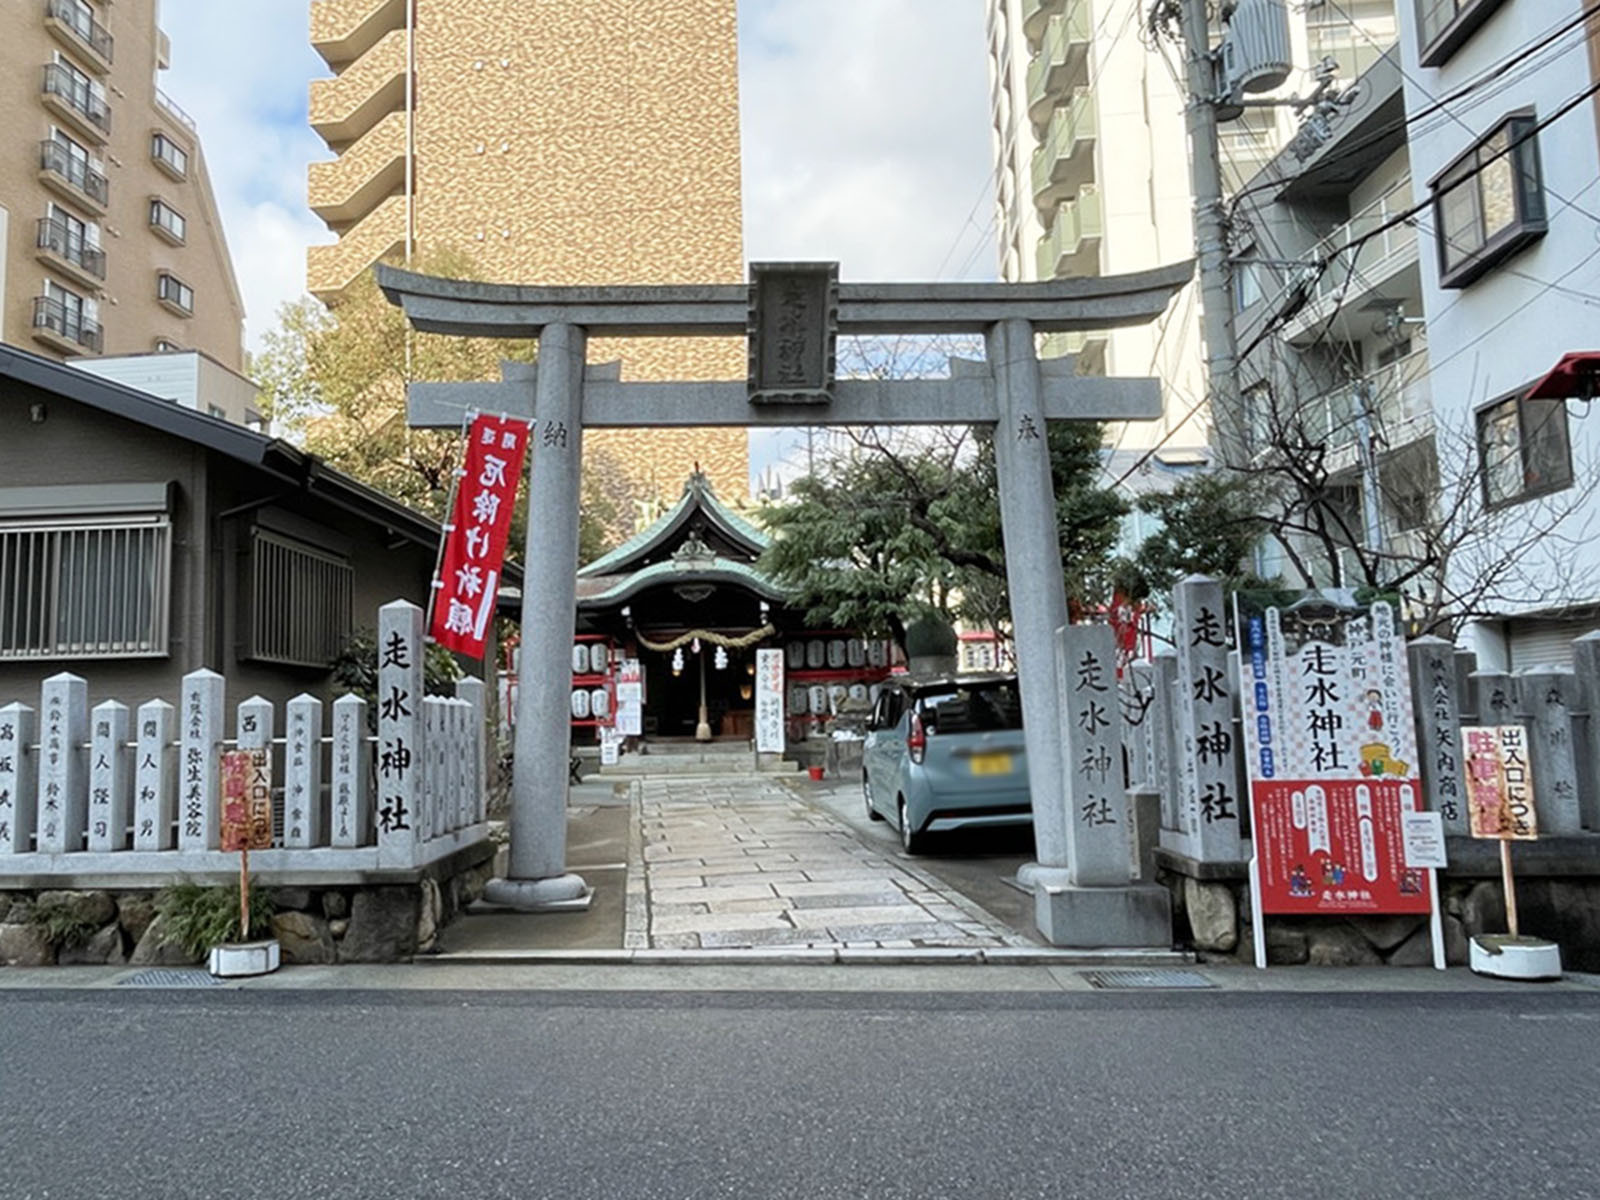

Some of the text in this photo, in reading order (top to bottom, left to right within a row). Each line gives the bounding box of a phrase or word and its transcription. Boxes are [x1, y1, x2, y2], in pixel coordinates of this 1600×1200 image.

[543, 420, 568, 448] 納
[378, 631, 412, 835] 走水神社
[1075, 651, 1117, 828] 走水神社
[1191, 607, 1236, 823] 走水神社
[1302, 645, 1348, 772] 走水神社
[1501, 729, 1530, 836] 出入口につき
